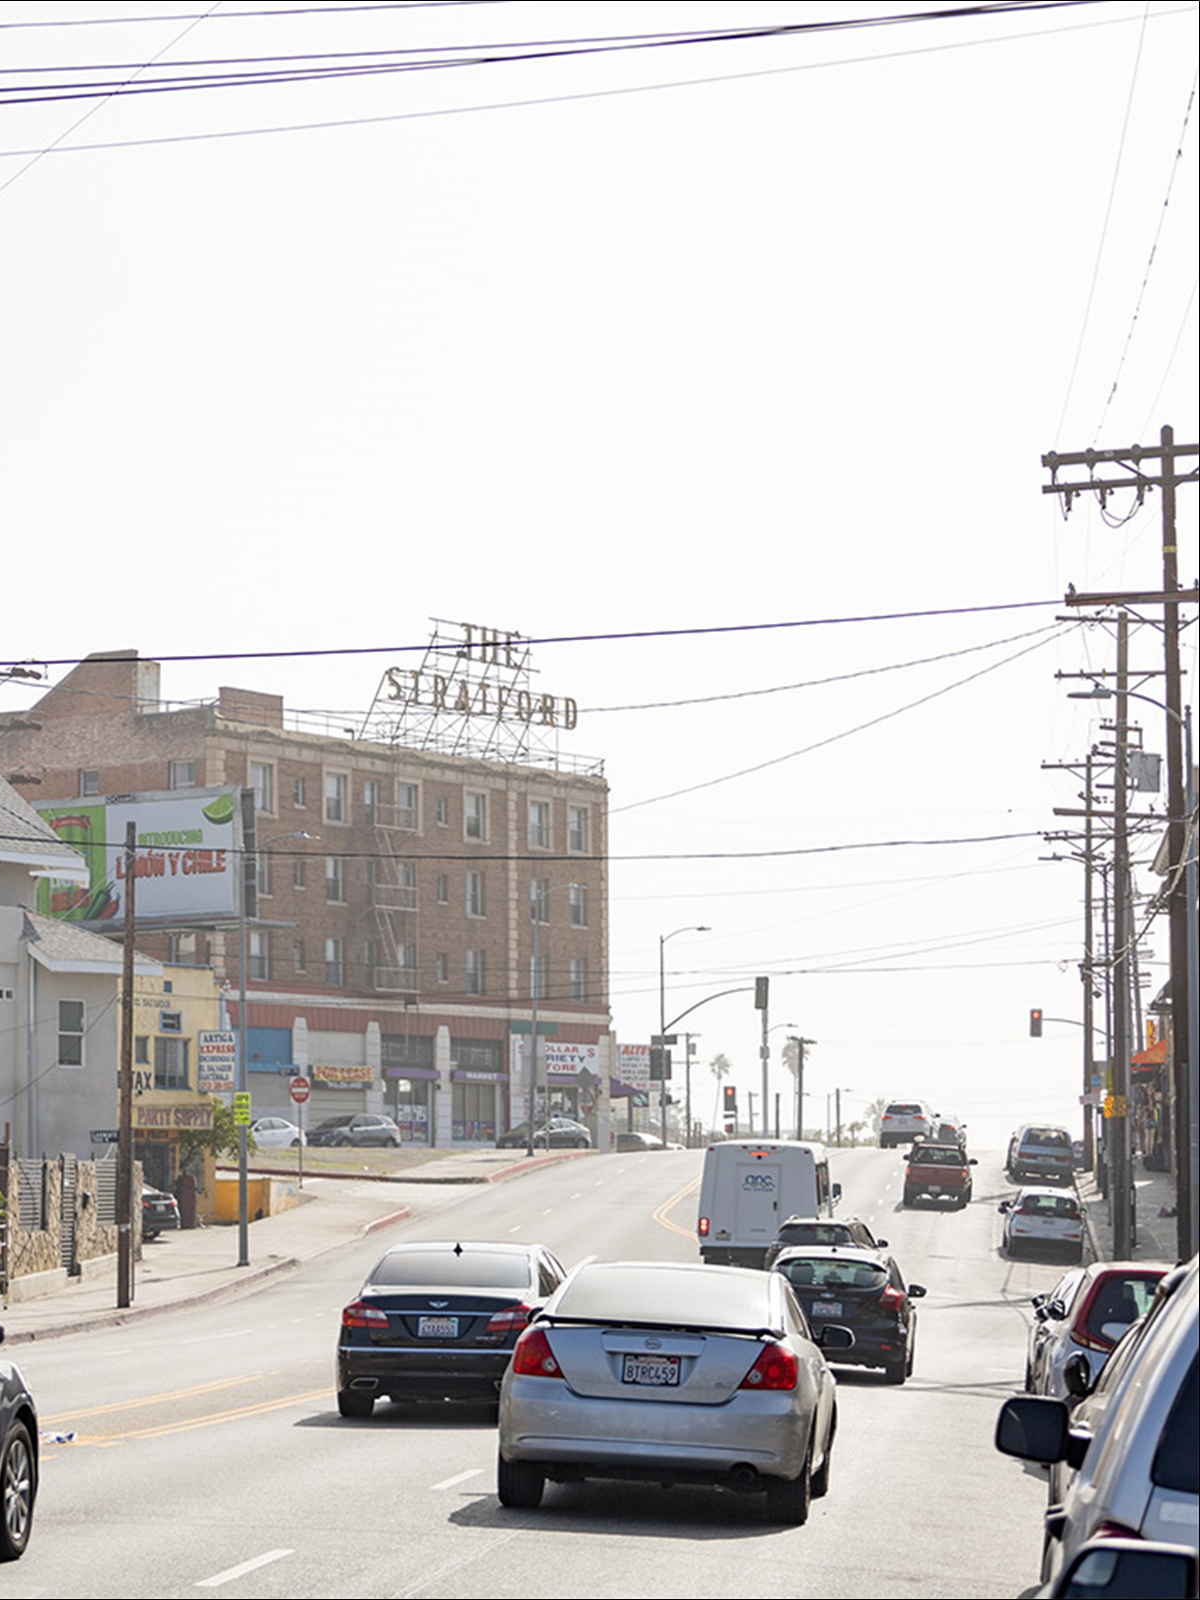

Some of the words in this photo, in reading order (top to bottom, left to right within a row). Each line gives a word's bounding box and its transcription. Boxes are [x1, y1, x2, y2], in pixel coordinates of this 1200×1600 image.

[460, 622, 522, 670] THE
[387, 667, 578, 730] STRATFORD
[138, 829, 203, 846] INTRODUCING
[116, 849, 165, 880] LMÓN
[168, 851, 180, 876] Y
[182, 849, 227, 875] CHILE
[203, 1034, 234, 1043] ARTIGA
[201, 1045, 235, 1054] EXPRESS
[545, 1045, 579, 1054] OLLAR
[546, 1055, 586, 1063] RIETY
[315, 1066, 339, 1080] FOR
[341, 1066, 373, 1080] LEASE
[547, 1063, 577, 1071] TORE
[465, 1072, 498, 1080] MARKET
[137, 1107, 172, 1127] PARTY
[174, 1107, 213, 1128] SUPPLY
[626, 1364, 677, 1381] 8TRC459
